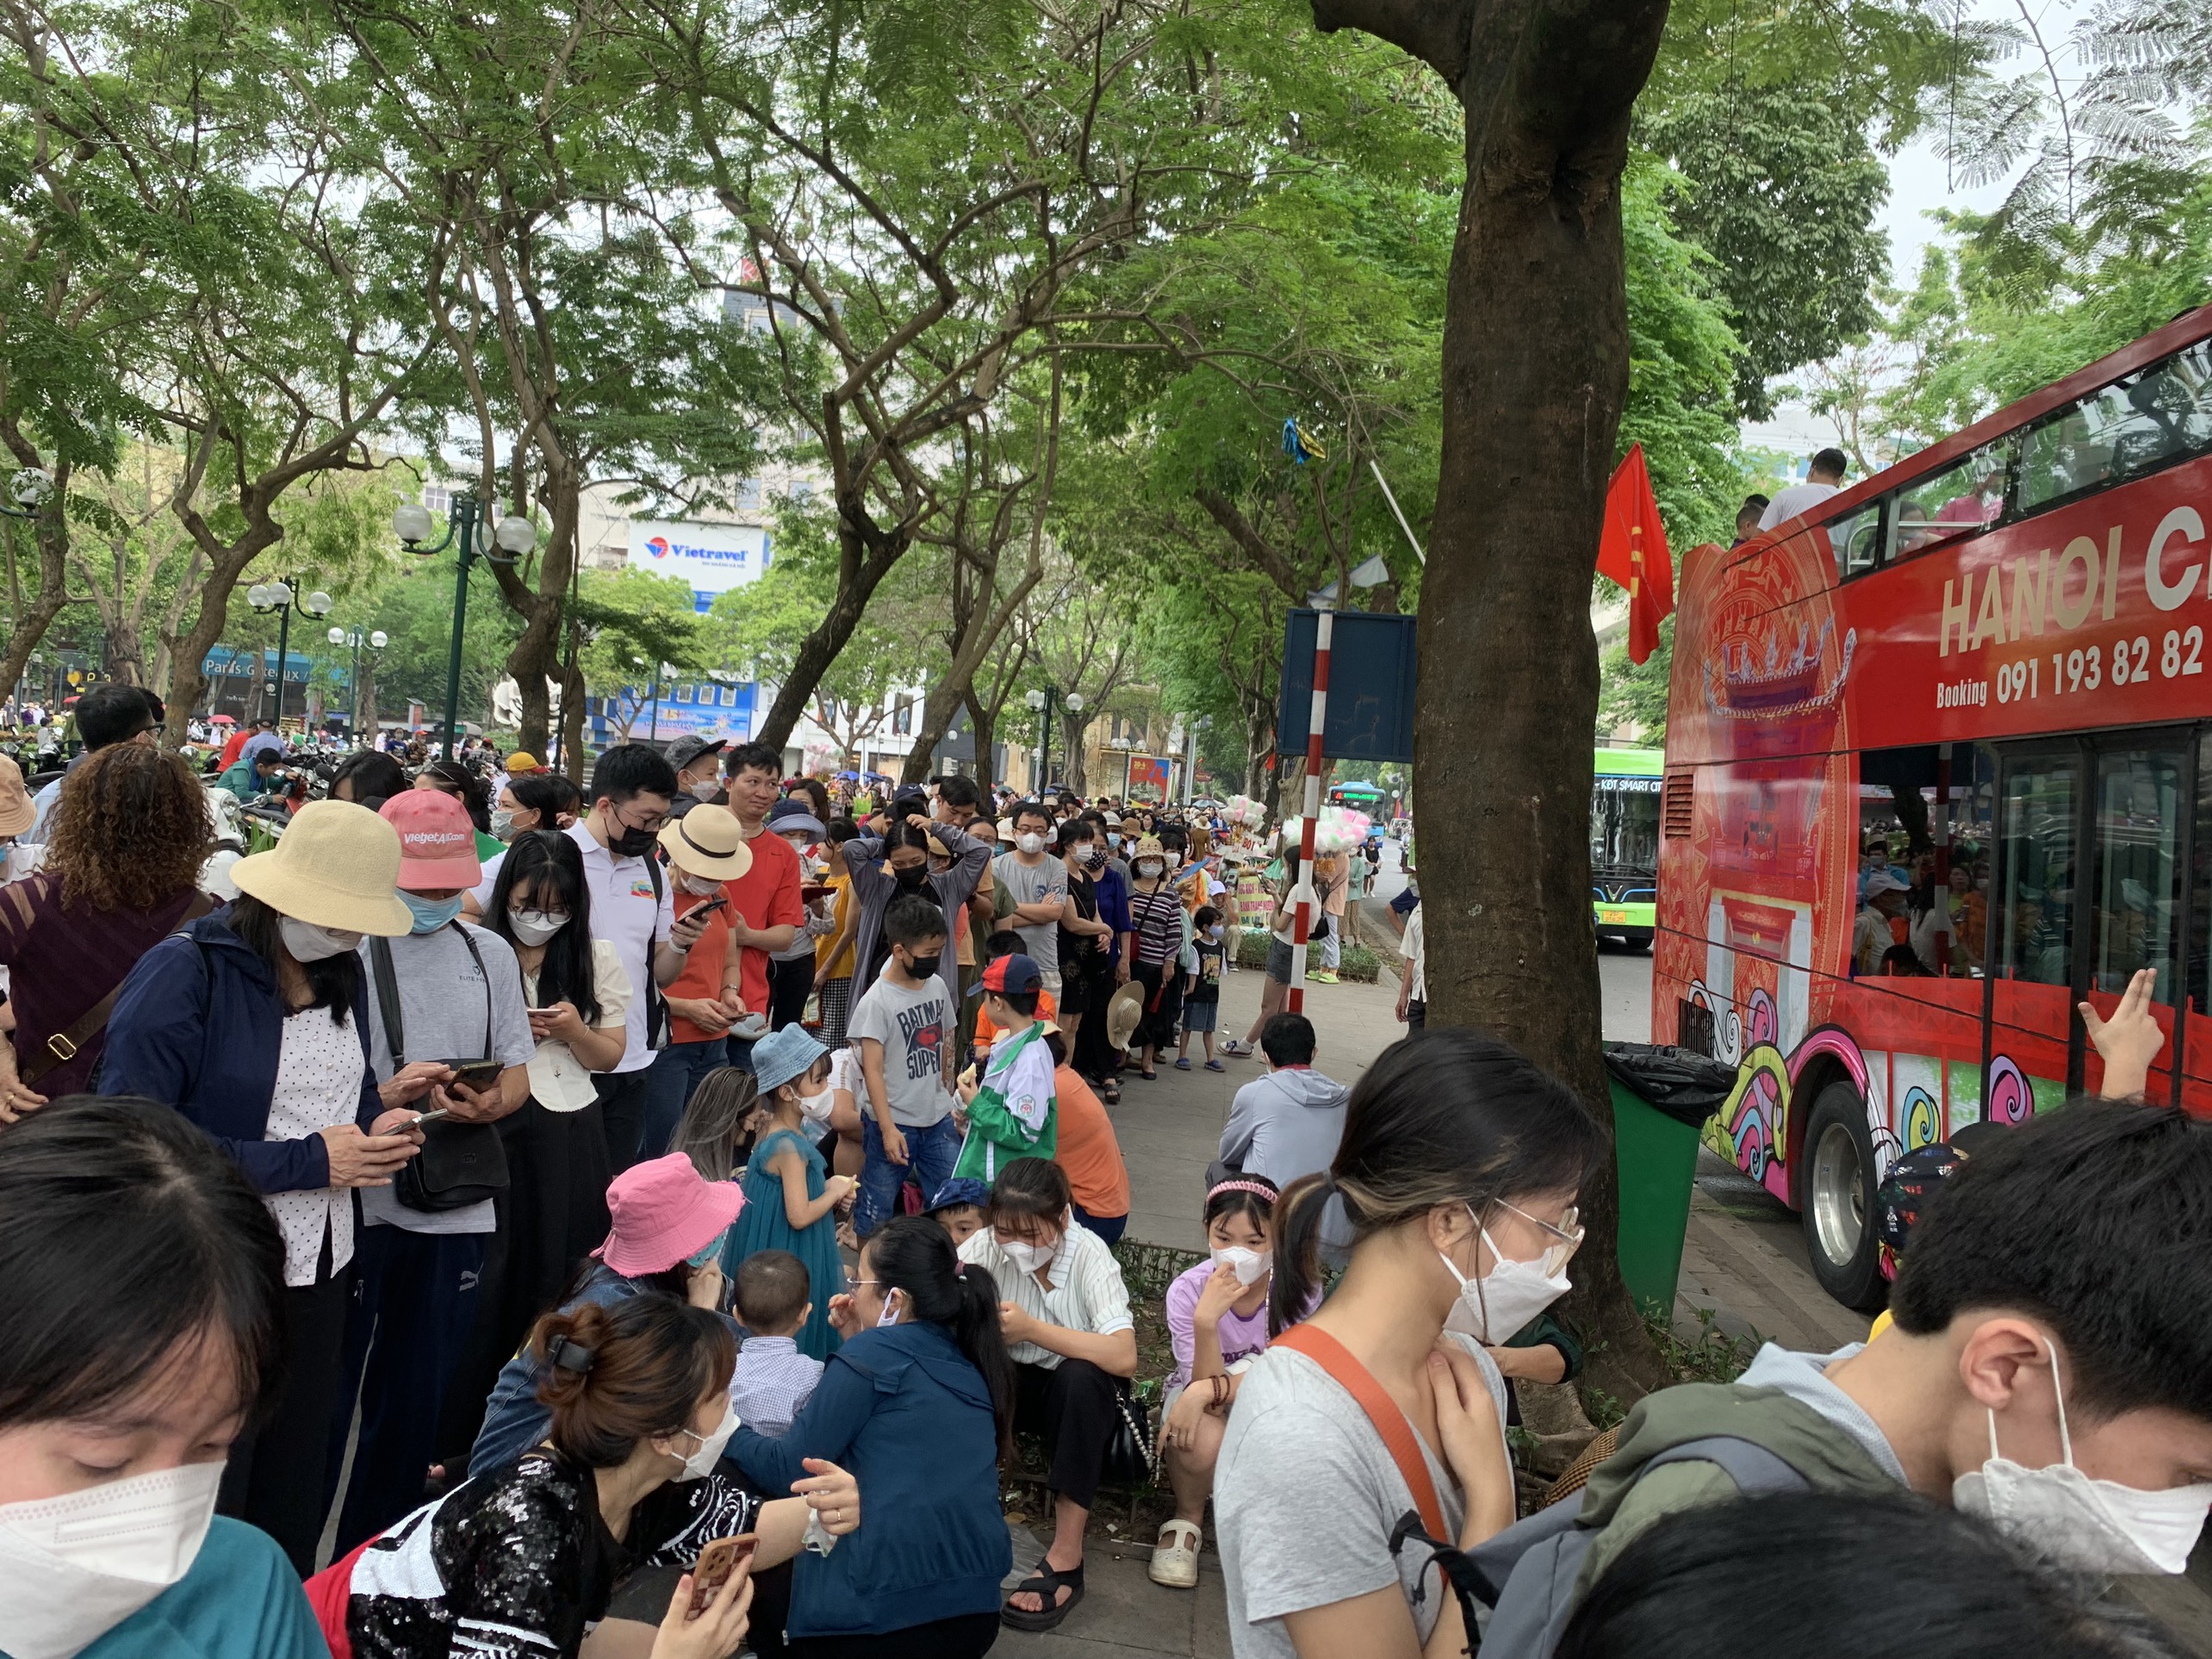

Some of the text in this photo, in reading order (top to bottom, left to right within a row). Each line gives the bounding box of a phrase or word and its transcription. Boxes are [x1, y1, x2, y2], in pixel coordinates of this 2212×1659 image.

[671, 544, 746, 562] Vietravel
[1939, 506, 2212, 658] HANOI C
[1937, 625, 2203, 709] Booking 091 193 82 82
[1619, 780, 1650, 792] SMART
[1650, 781, 1663, 792] CIT
